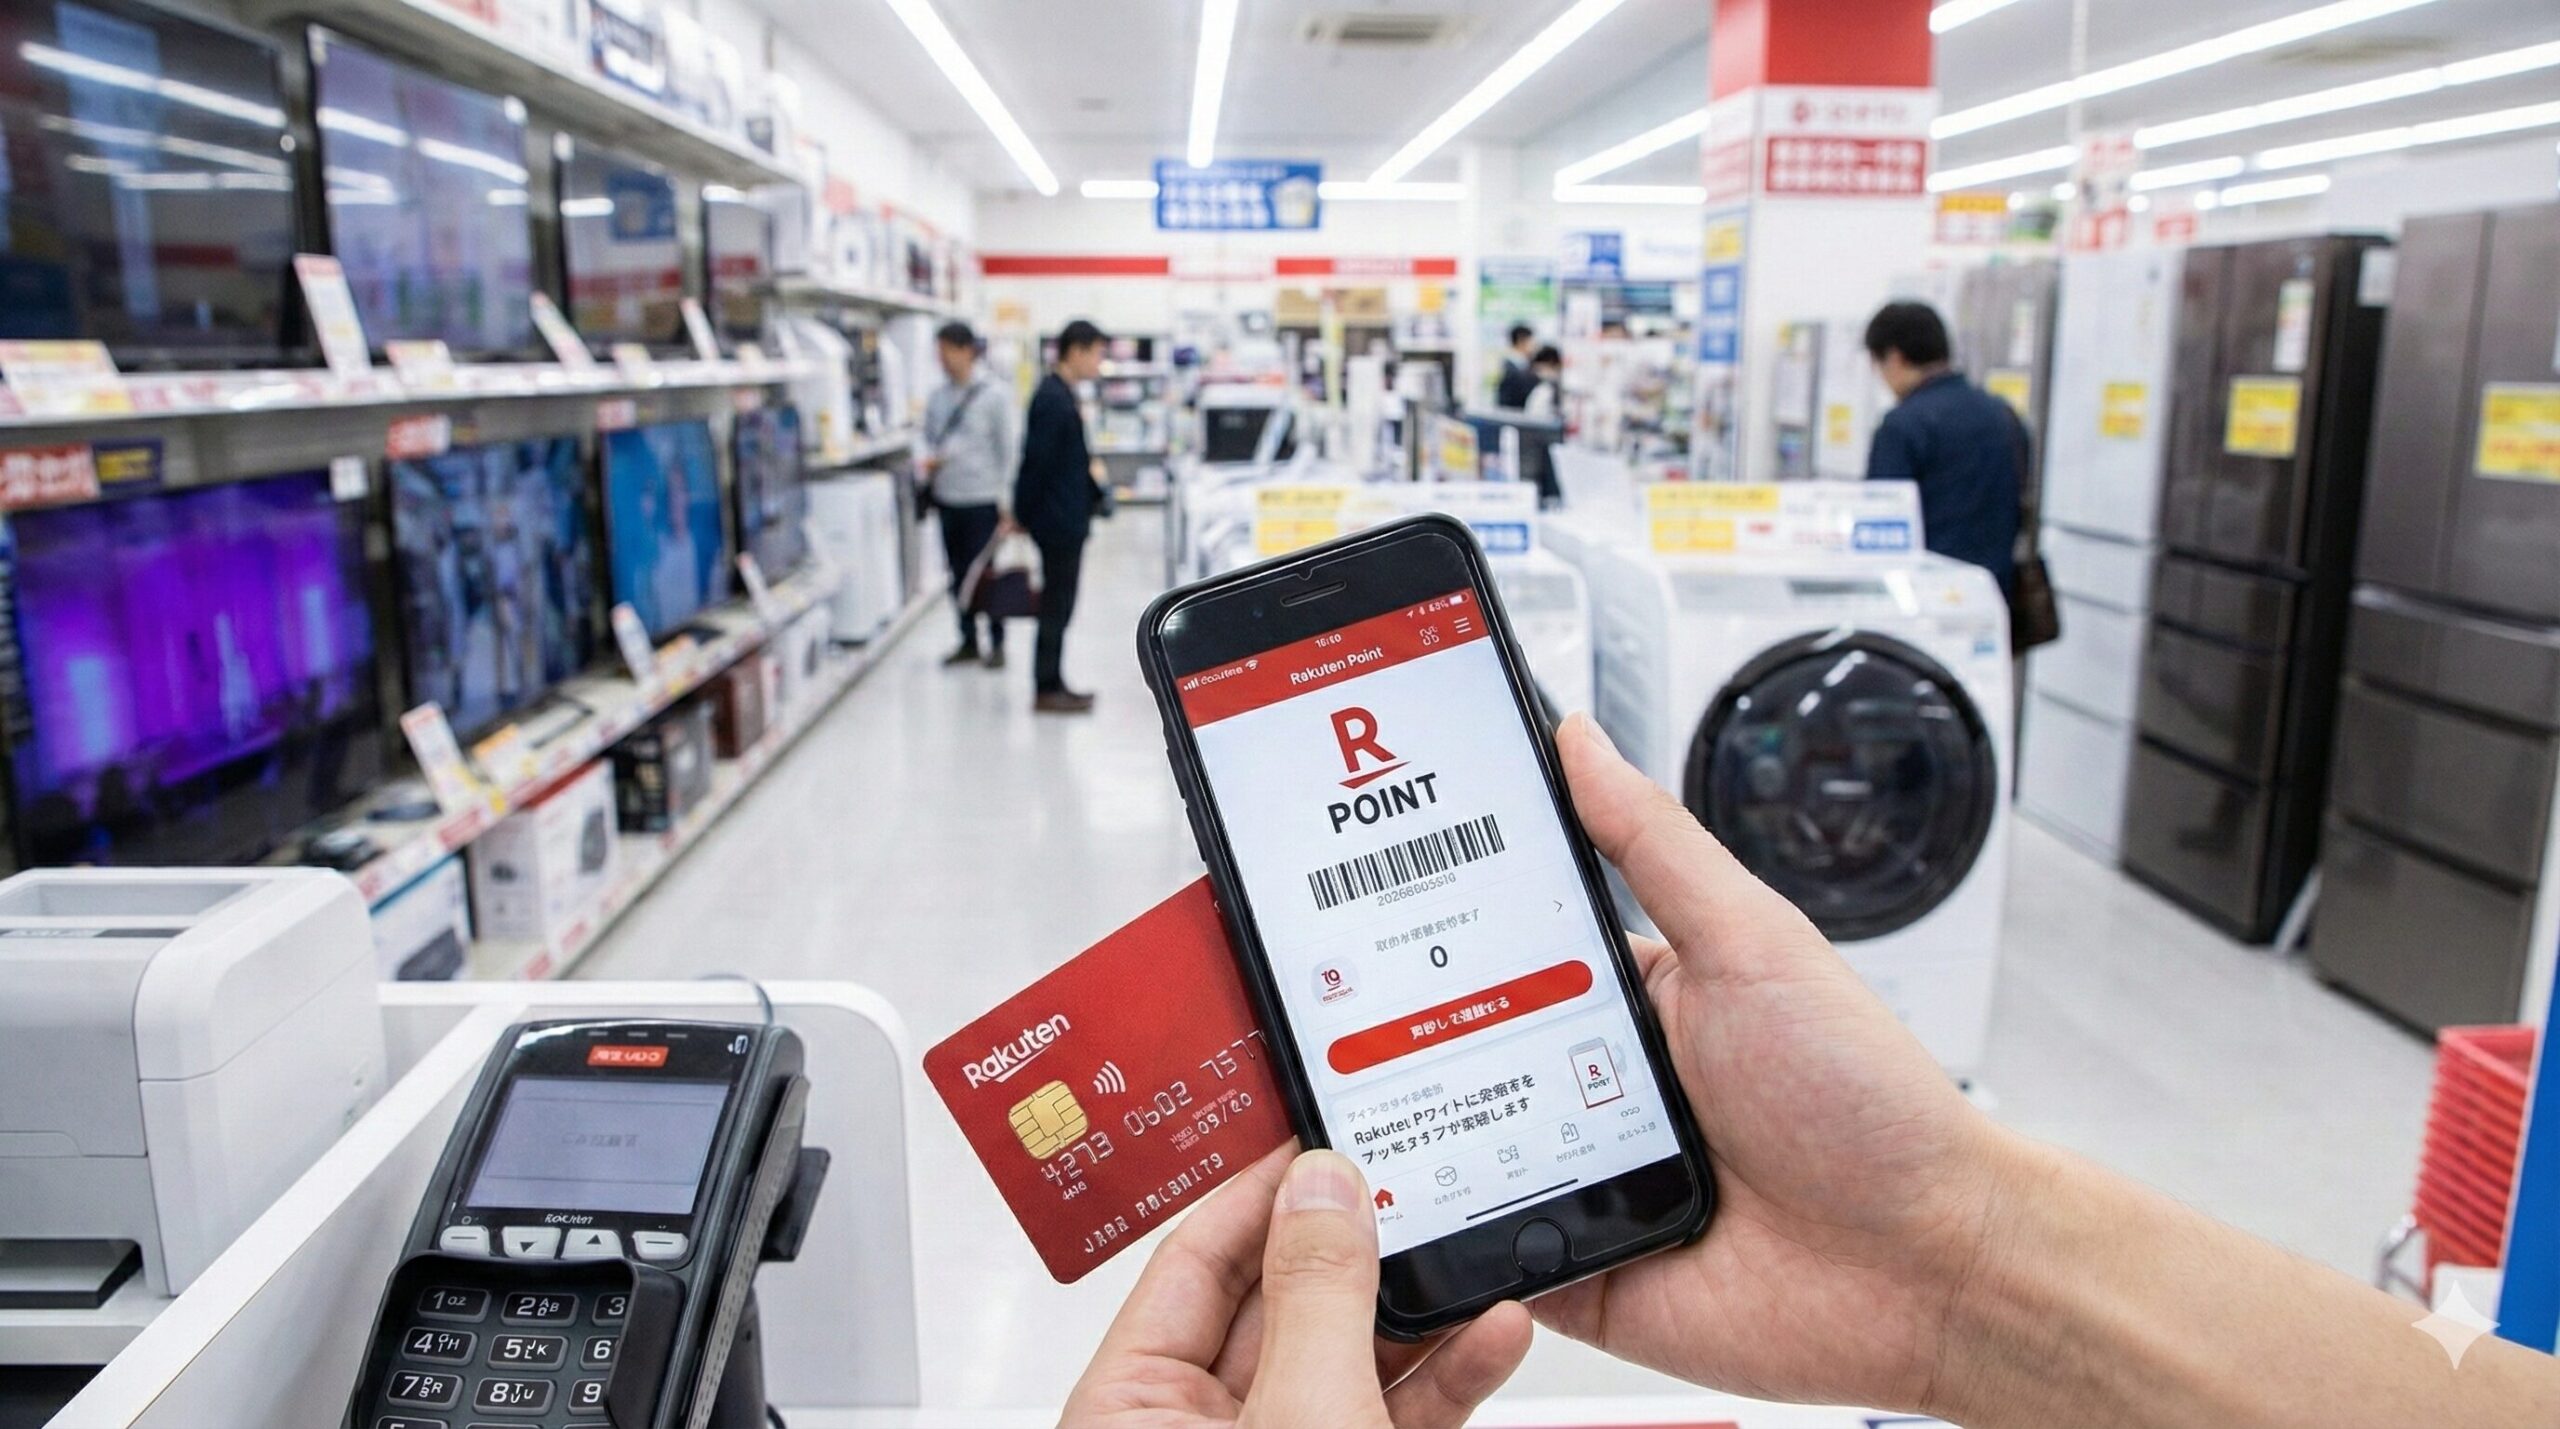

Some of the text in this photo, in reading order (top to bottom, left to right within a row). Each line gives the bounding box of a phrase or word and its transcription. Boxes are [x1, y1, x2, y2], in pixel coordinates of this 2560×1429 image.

[1290, 646, 1384, 686] Rakuten Point
[1330, 706, 1397, 773] R
[1327, 772, 1437, 834] POINT
[1429, 945, 1448, 968] 0
[961, 1013, 1071, 1089] Rakuten
[433, 1290, 444, 1310] 1
[516, 1297, 535, 1316] 2
[414, 1333, 432, 1353] 4
[504, 1339, 522, 1359] 5
[592, 1340, 612, 1360] 6
[400, 1376, 420, 1396] 7
[490, 1382, 509, 1403] 8
[582, 1383, 601, 1403] 9
